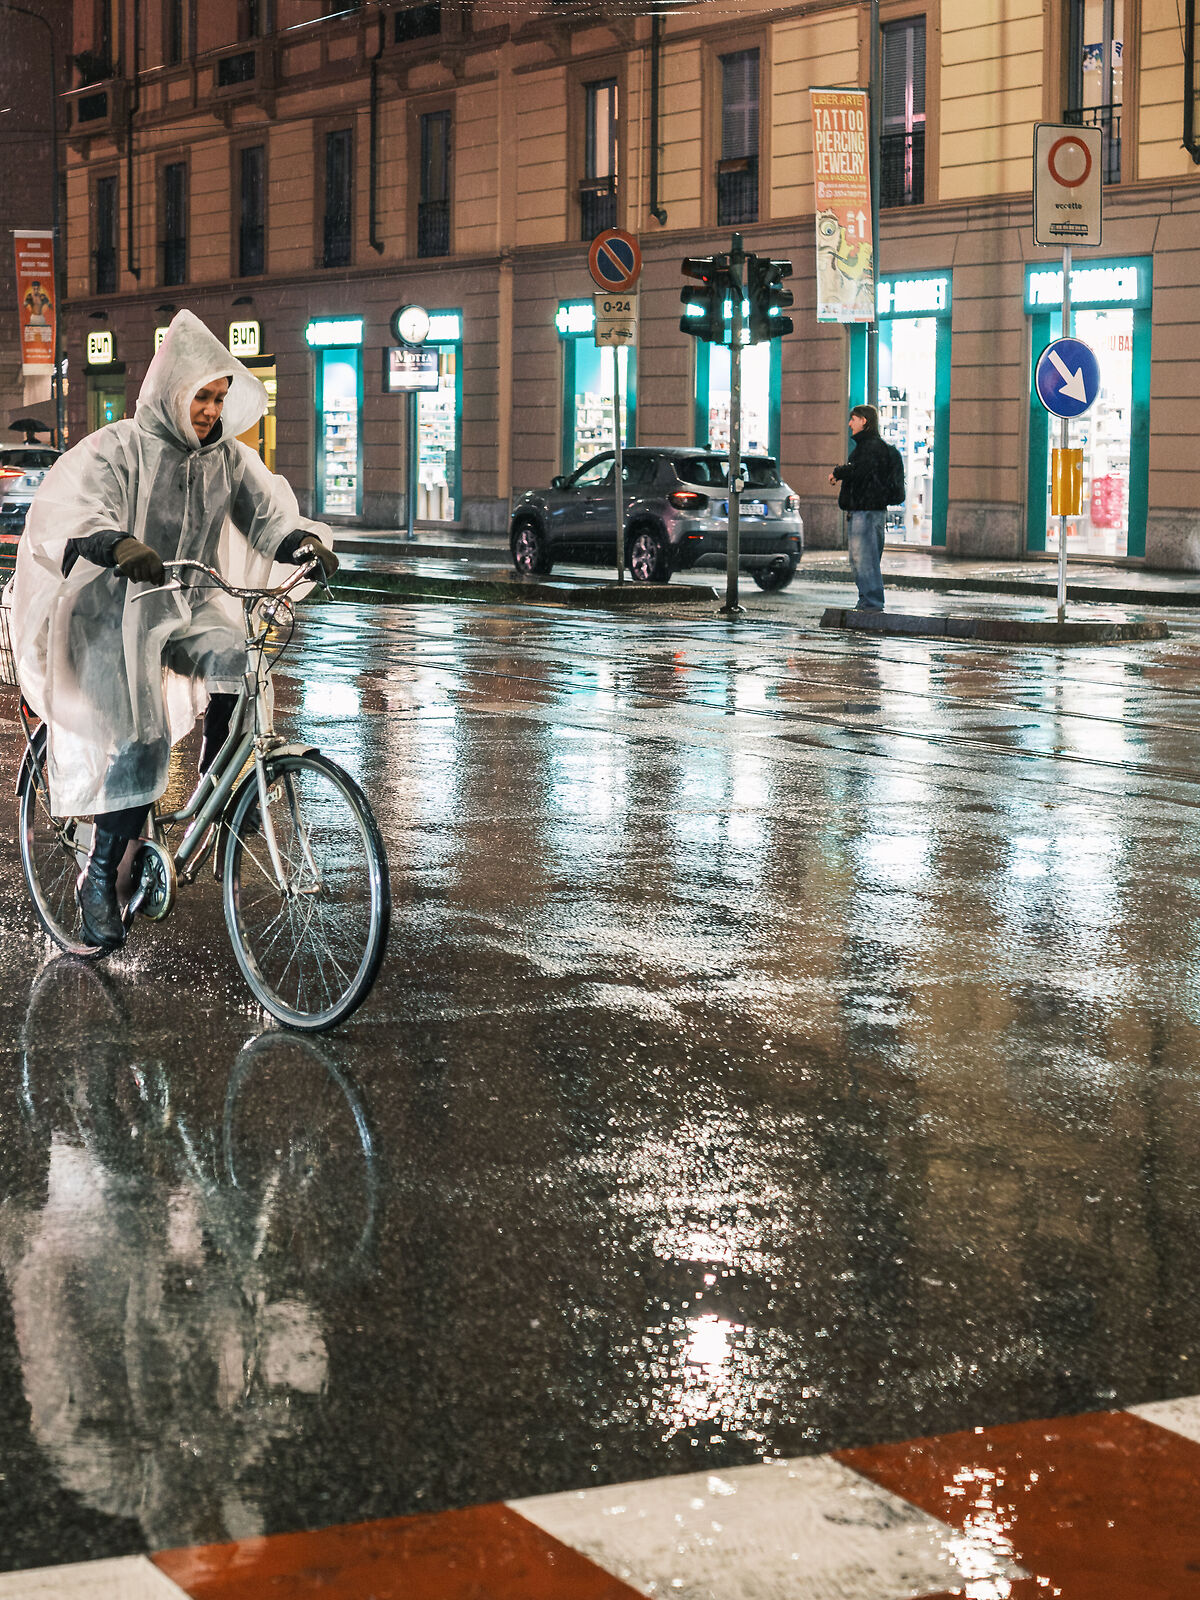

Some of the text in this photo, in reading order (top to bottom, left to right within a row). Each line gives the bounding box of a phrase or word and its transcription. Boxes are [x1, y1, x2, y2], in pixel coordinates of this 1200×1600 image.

[814, 108, 864, 131] TATTOO
[815, 130, 865, 153] PIERCING
[817, 152, 865, 175] JEWELRY
[603, 301, 631, 312] 0-24
